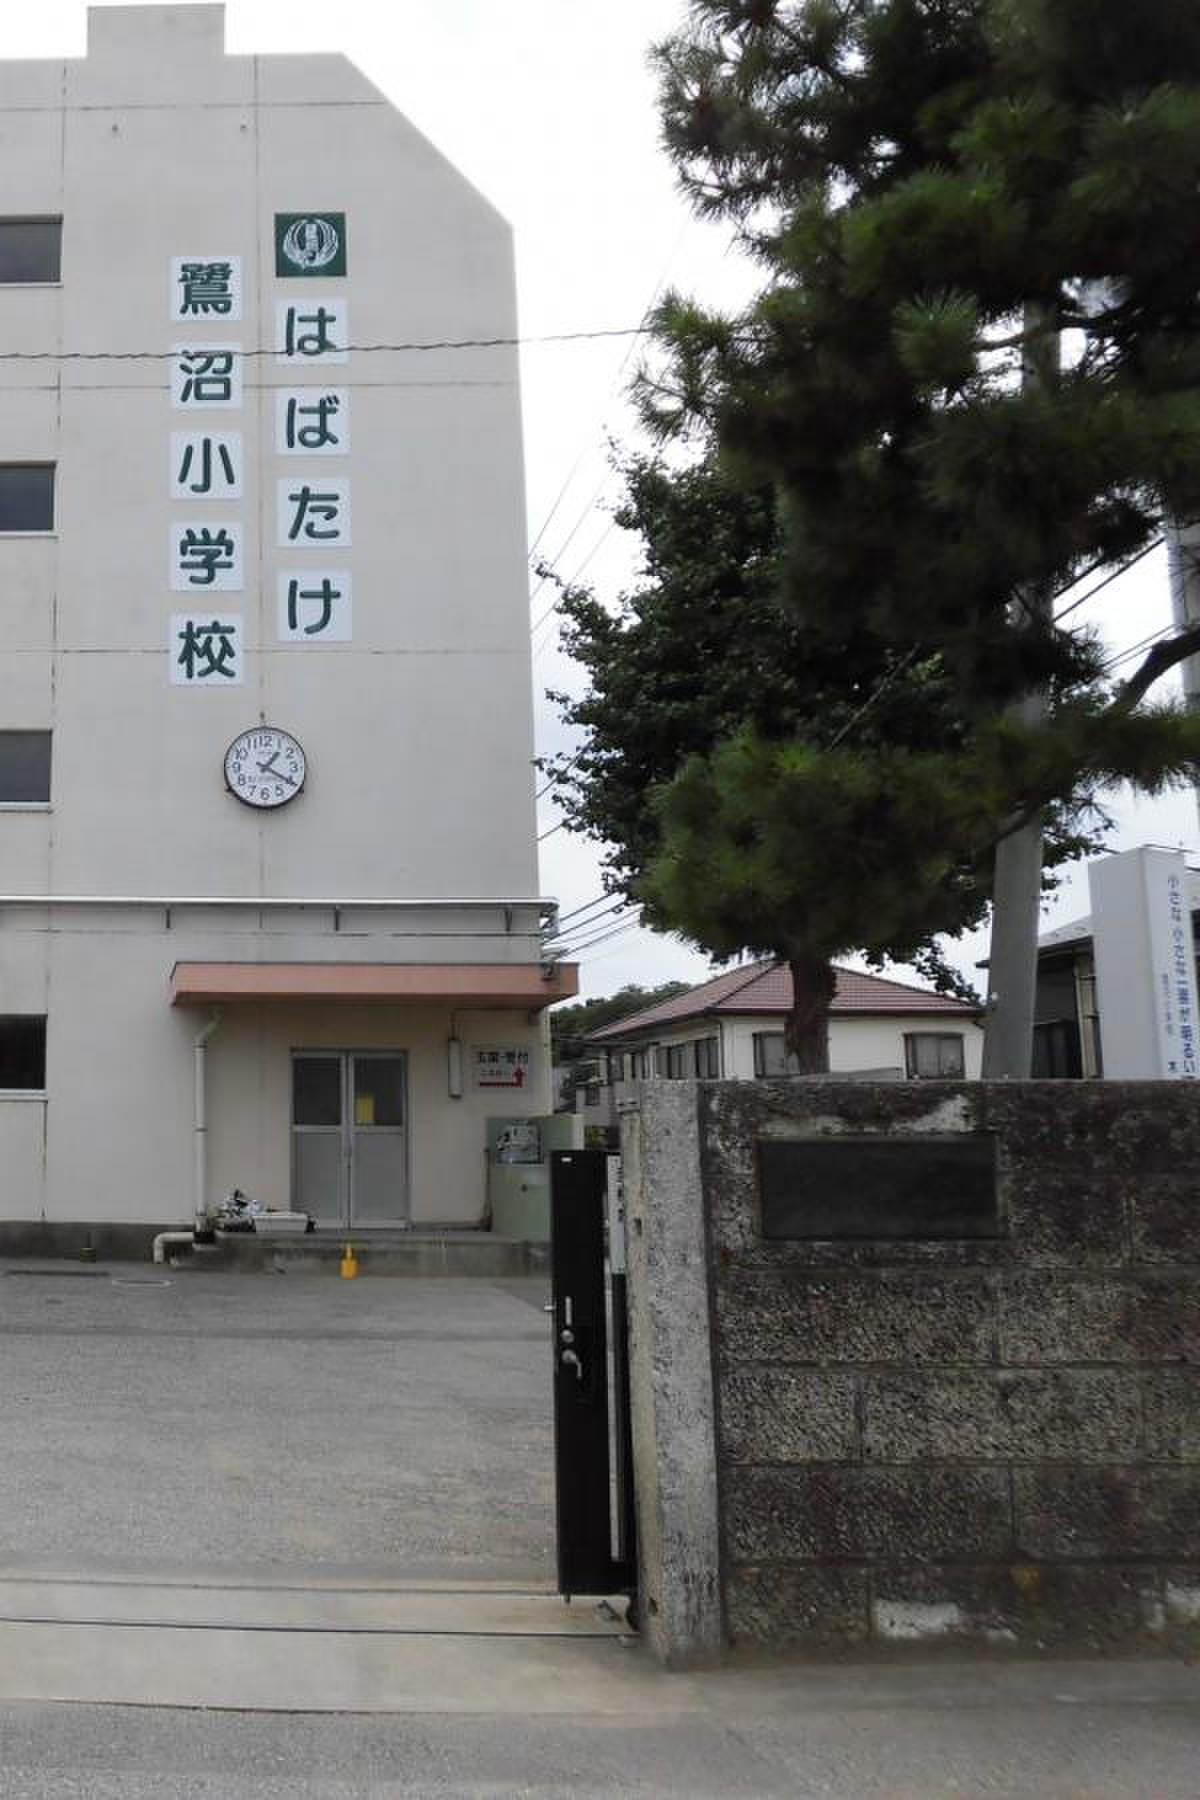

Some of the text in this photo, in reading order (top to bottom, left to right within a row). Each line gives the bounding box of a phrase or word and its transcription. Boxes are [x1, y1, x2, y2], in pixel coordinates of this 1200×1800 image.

[178, 261, 236, 680] 鷺沼小学校
[285, 306, 341, 635] はばたけ
[260, 735, 272, 747] 12
[236, 747, 248, 760] 10
[286, 747, 294, 759] 2
[232, 761, 240, 773] 9
[289, 761, 298, 773] 3
[238, 773, 246, 786] 8
[248, 785, 256, 796] 7
[261, 787, 270, 800] 6
[275, 785, 284, 796] 5
